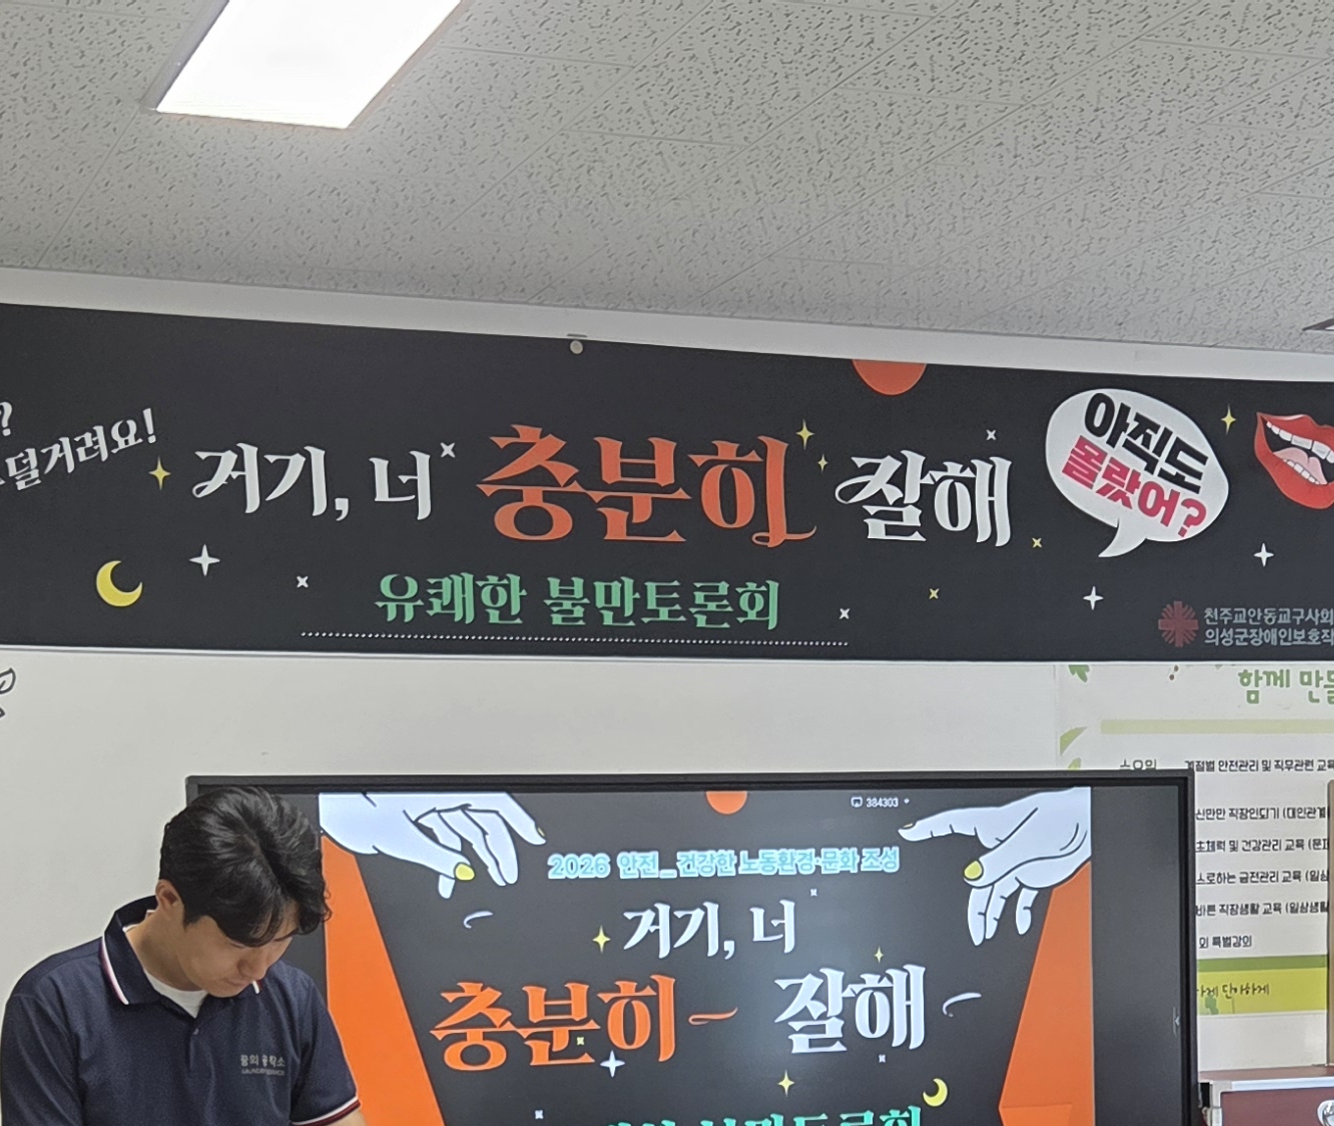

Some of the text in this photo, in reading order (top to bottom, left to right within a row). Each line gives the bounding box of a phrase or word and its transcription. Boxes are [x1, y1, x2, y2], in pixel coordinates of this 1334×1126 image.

[1084, 391, 1209, 495] 아직도
[189, 424, 1013, 548] 거기, 너 충분히 잘해
[1061, 434, 1208, 538] 몰랐어?
[374, 570, 781, 634] 유쾌한 불만토론회
[1237, 668, 1291, 705] 함께
[1218, 759, 1259, 772] 안전관리
[1261, 759, 1271, 772] 및
[1274, 758, 1315, 772] 직무관련
[1228, 807, 1280, 821] 직장인되기
[547, 852, 611, 880] 2026
[737, 846, 859, 876] 노동환경·문화
[860, 845, 901, 873] 조성
[1241, 838, 1282, 852] 건강관리
[1284, 838, 1305, 851] 교육
[1239, 870, 1279, 884] 금전관리
[1281, 870, 1302, 883] 교육
[1218, 902, 1260, 916] 직장생활
[1262, 902, 1283, 915] 교육
[621, 898, 797, 962] 거기, 너
[1211, 935, 1253, 949] 특별강의
[428, 963, 927, 1072] 충분히 잘해
